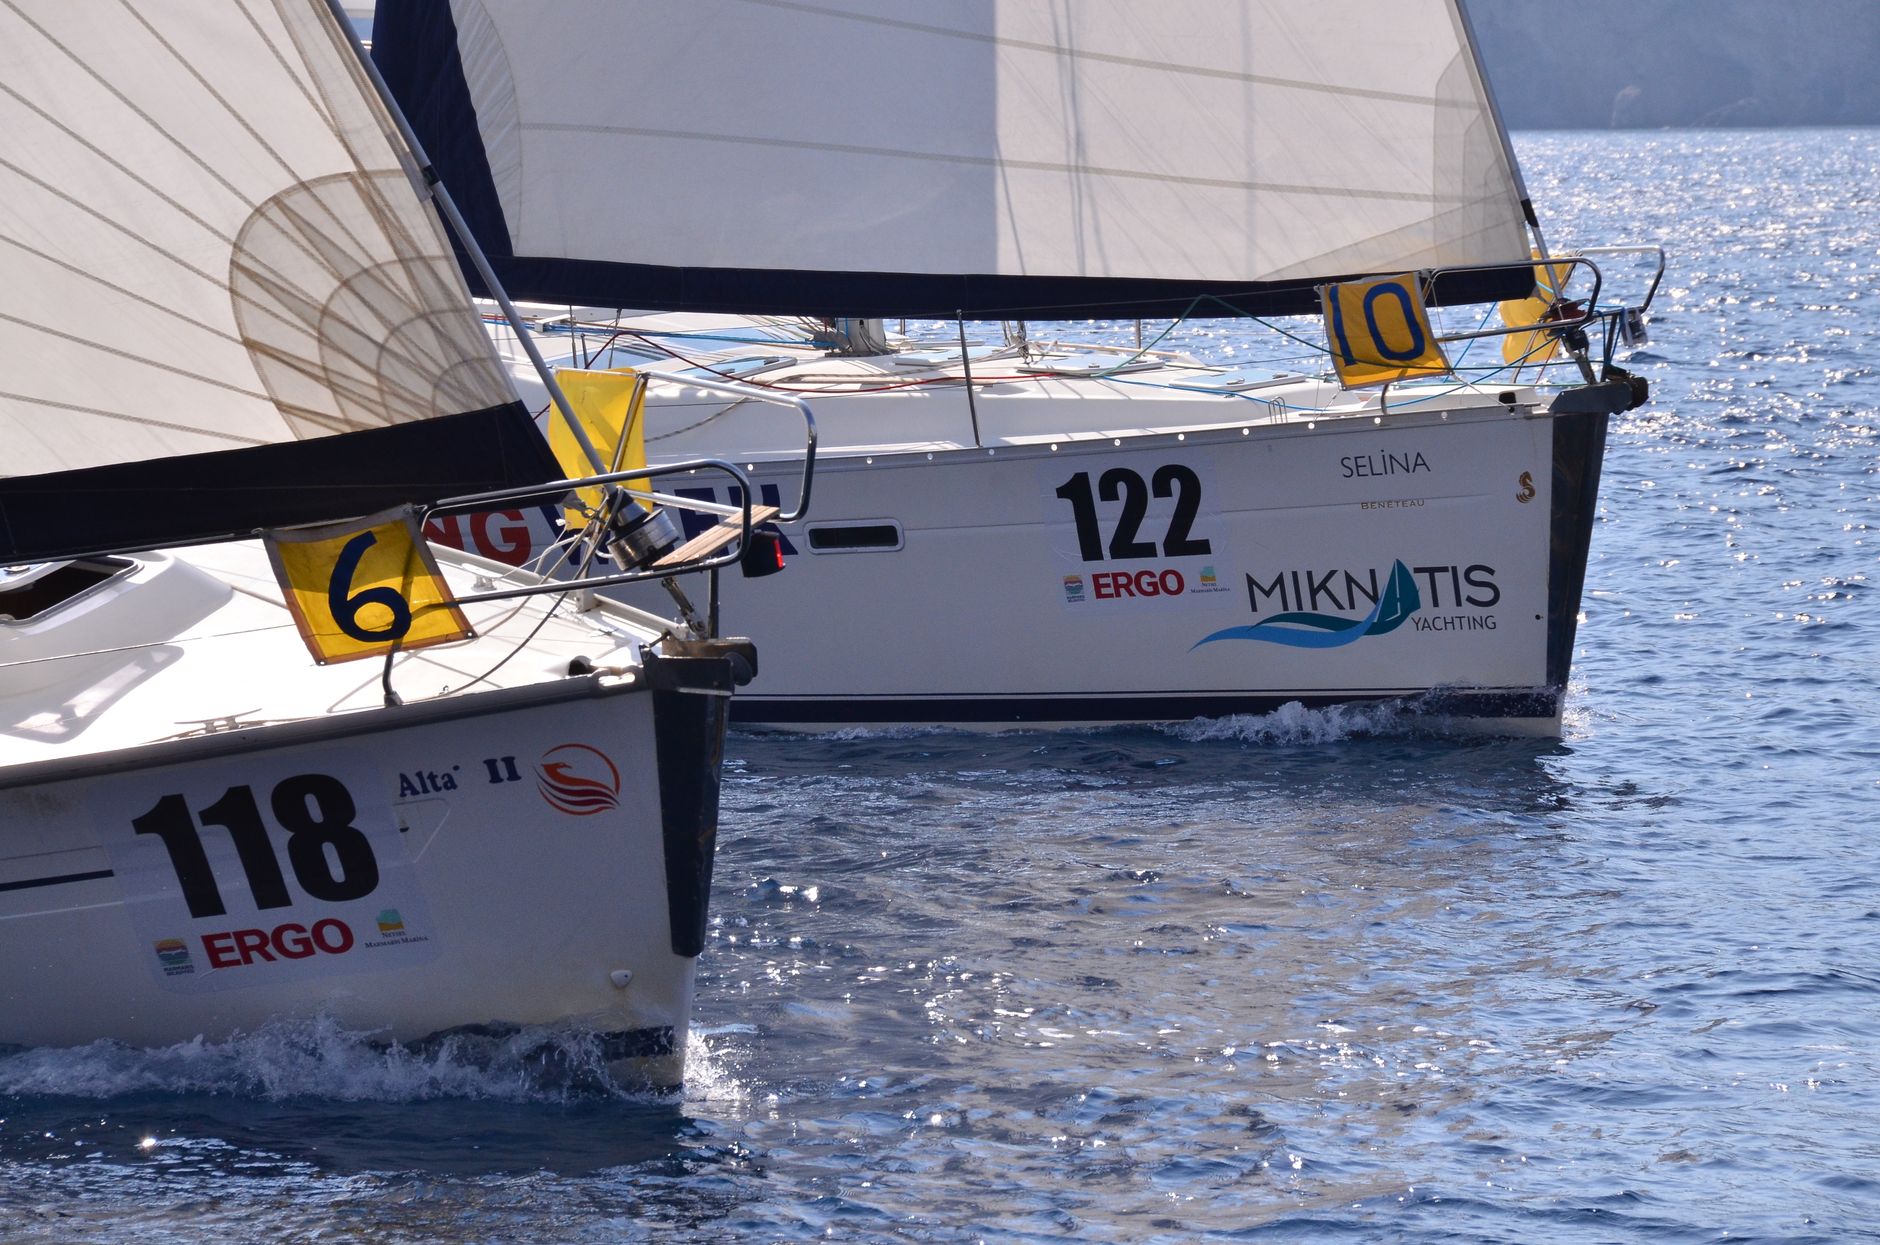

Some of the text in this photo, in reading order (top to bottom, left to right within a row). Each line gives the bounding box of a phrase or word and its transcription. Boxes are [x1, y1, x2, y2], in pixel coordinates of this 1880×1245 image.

[1328, 281, 1426, 367] 10
[1055, 464, 1212, 562] 122
[1360, 499, 1426, 510] BENETEAU
[328, 530, 412, 643] 6
[1091, 569, 1185, 600] ERGO
[1410, 615, 1497, 632] YACHTING
[131, 773, 380, 919] 118
[200, 917, 355, 969] ERGO
